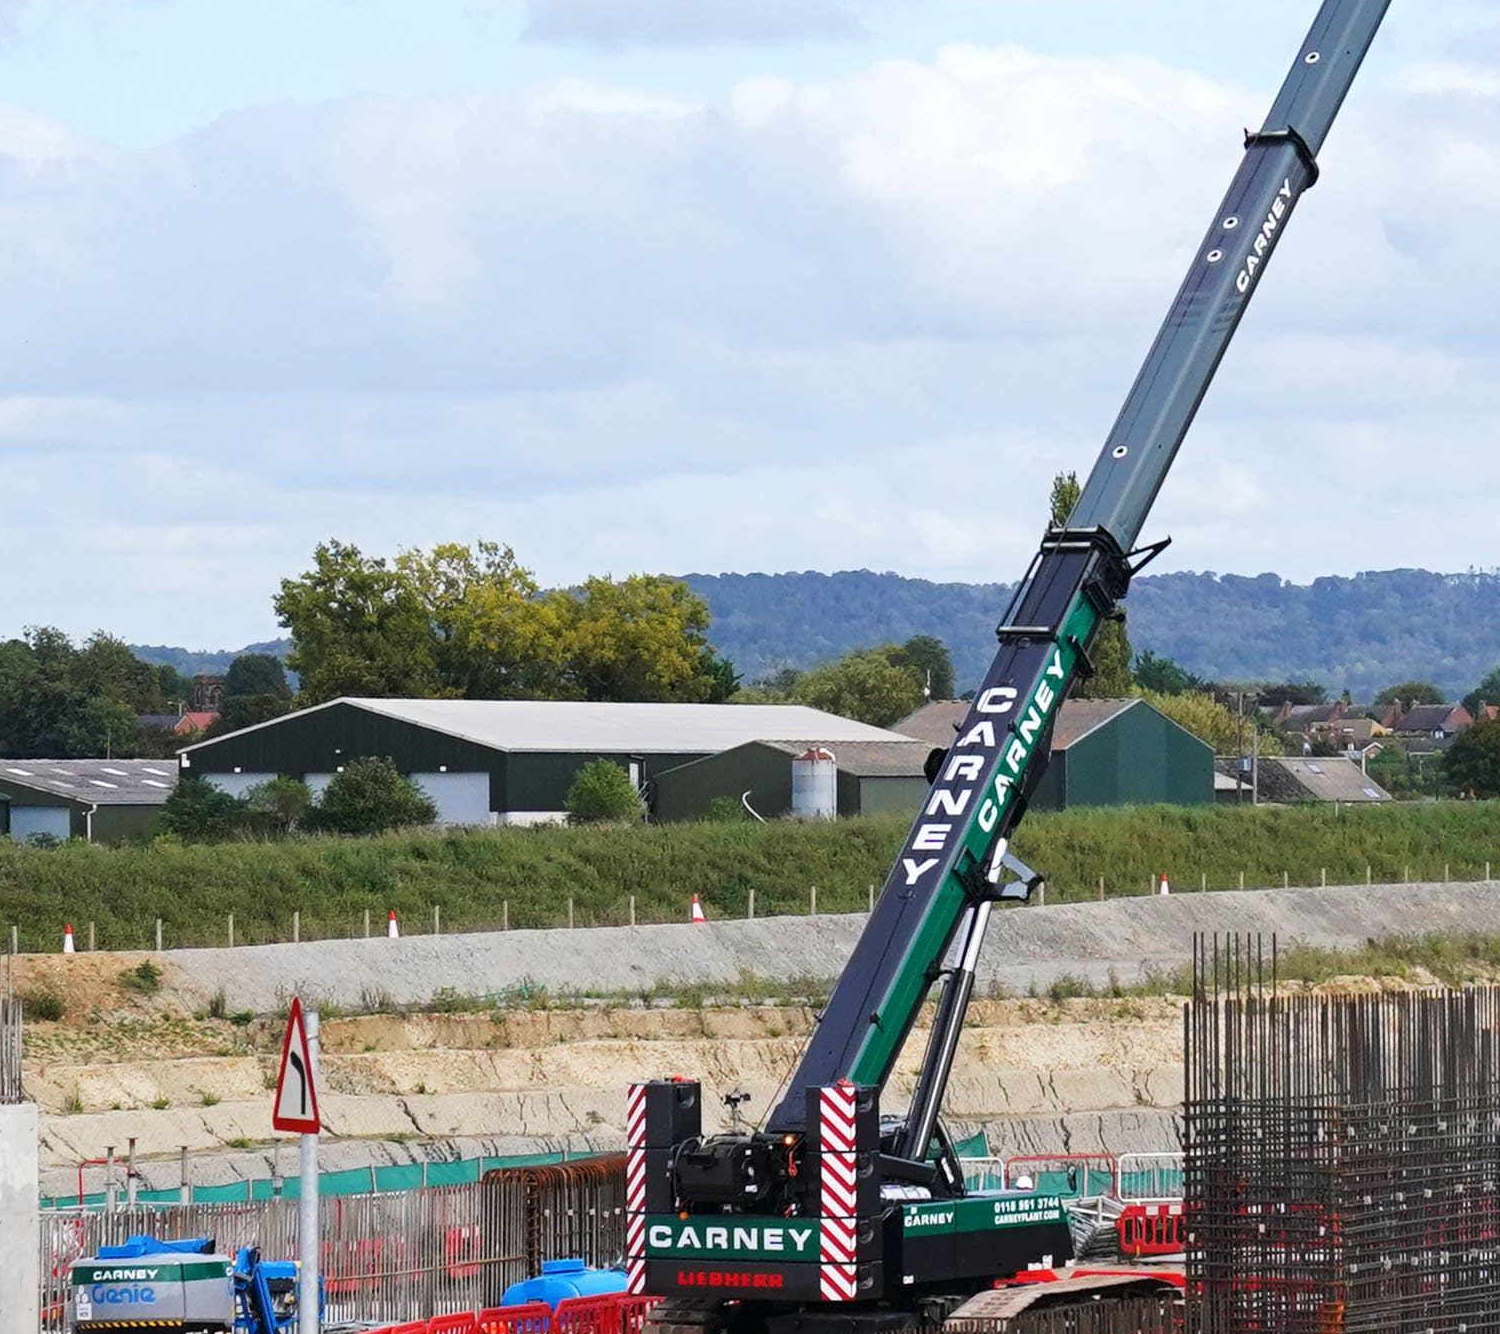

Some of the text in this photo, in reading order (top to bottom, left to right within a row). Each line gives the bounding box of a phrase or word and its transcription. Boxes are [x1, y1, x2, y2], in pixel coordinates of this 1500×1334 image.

[1235, 178, 1296, 294] CARNEY
[978, 649, 1064, 833] CARNEY
[903, 687, 1017, 885] CARNEY
[904, 1212, 954, 1227] CARNEY
[649, 1225, 813, 1251] CARNEY
[93, 1268, 159, 1281] CARNEY
[677, 1271, 784, 1288] LIEBHERR
[91, 1283, 155, 1305] Genie
